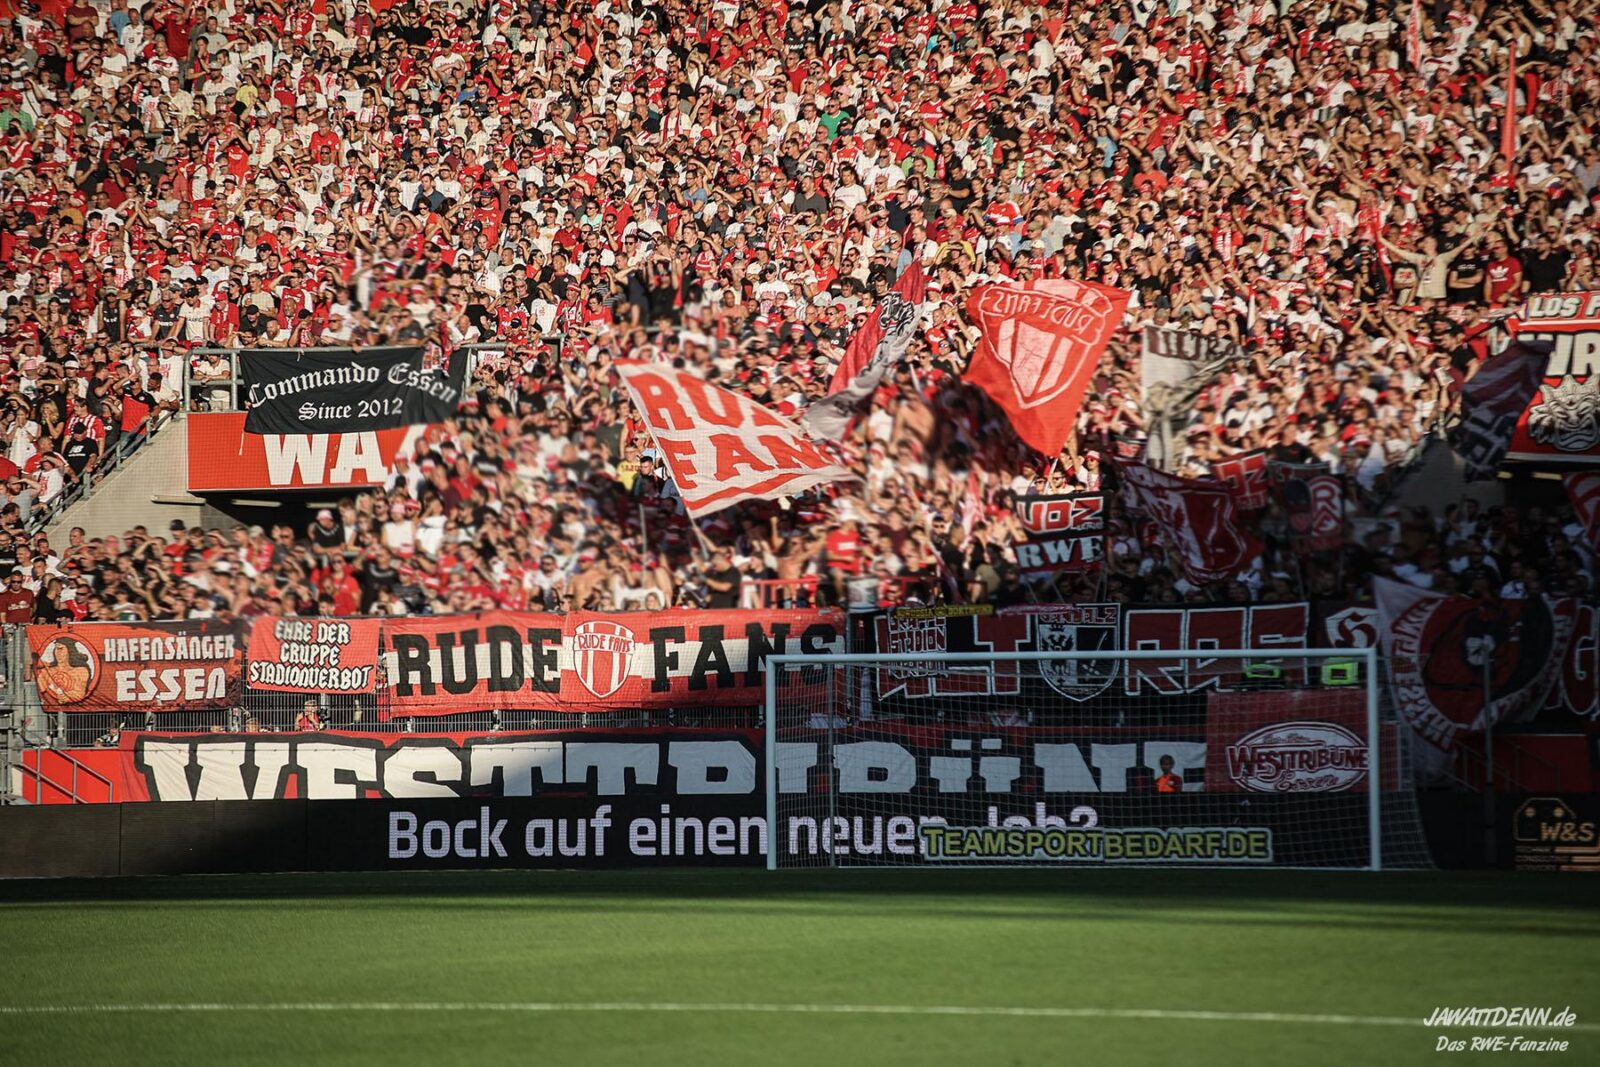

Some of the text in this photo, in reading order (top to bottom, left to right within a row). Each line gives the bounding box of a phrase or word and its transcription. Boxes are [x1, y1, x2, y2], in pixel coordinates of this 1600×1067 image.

[1533, 297, 1581, 318] LOS
[248, 361, 457, 408] Commando Essen
[297, 397, 404, 421] Since 2012
[625, 373, 788, 430] RU
[656, 433, 836, 490] FAN
[1016, 535, 1105, 569] RWE
[104, 631, 235, 663] HAFENSÄNGER
[274, 620, 350, 643] EHRE DER
[577, 634, 632, 653] RUDE FANS
[279, 644, 340, 666] GRUPPE
[392, 623, 840, 697] RUDE FANS
[115, 667, 226, 703] ESSEN
[249, 661, 373, 690] STADIONVERBOT
[1226, 744, 1369, 780] WESTTRIBÜNE
[388, 806, 510, 860] Bock
[525, 805, 612, 858] auf
[628, 804, 768, 858] einen
[921, 826, 1268, 859] TEAMSPORTBEDARF.DE
[1539, 821, 1596, 843] W&S
